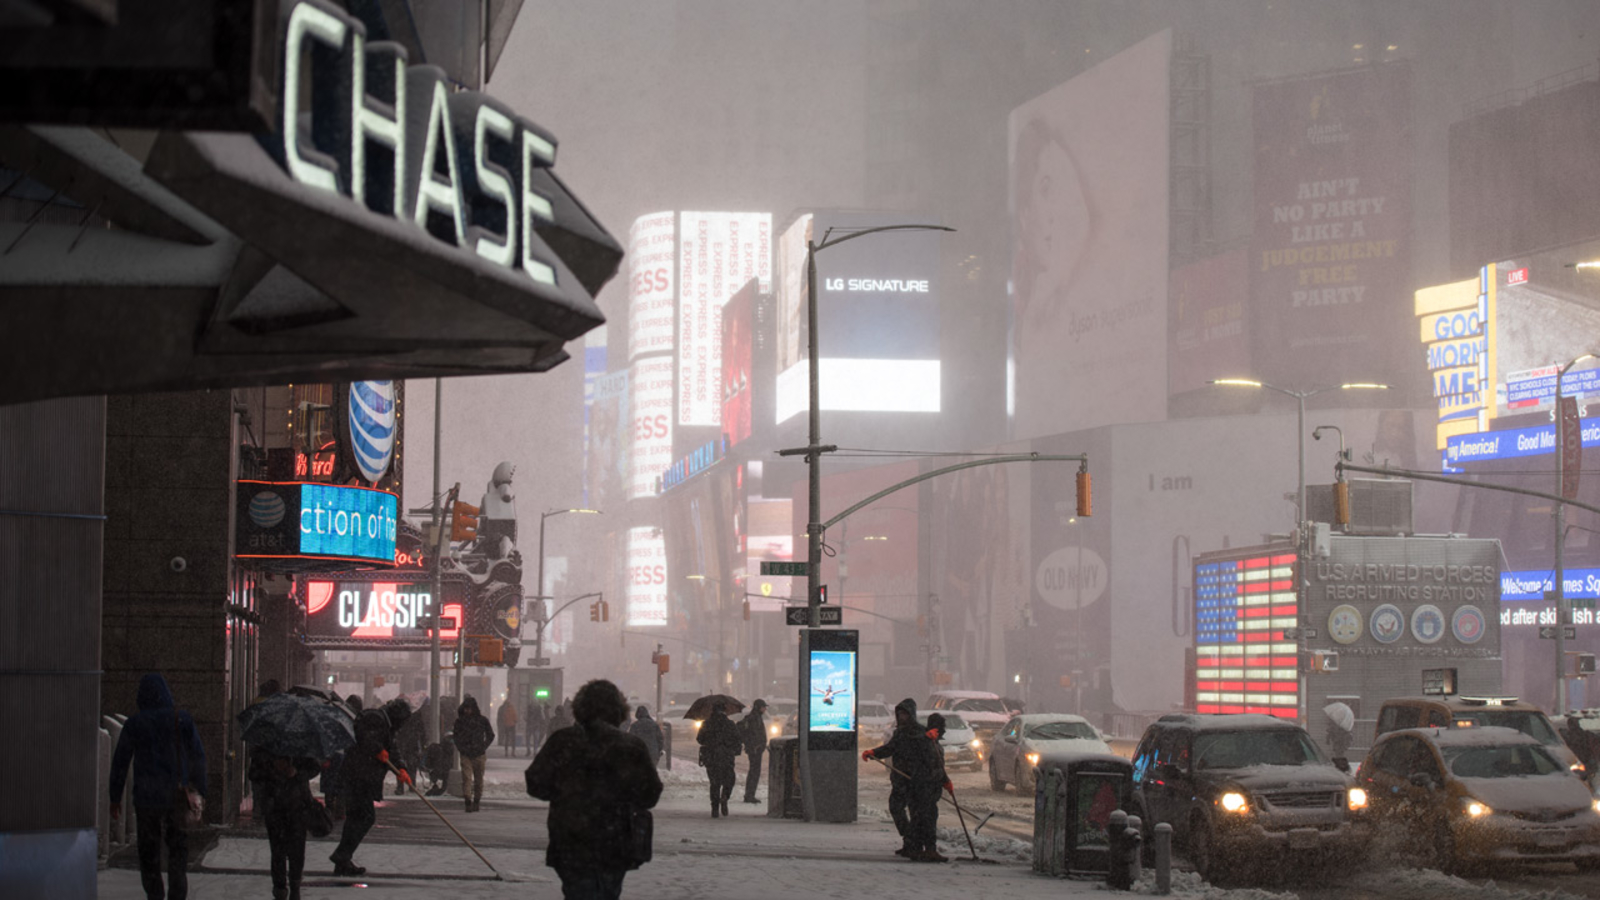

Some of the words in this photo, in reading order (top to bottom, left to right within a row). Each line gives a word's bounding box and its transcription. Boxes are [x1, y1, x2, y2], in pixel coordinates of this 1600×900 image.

[284, 2, 556, 286] CHASE
[1297, 177, 1359, 200] AIN'T
[1273, 205, 1305, 223] NO
[1311, 197, 1385, 220] PARTY
[1291, 222, 1344, 243] LIKE
[1350, 220, 1366, 239] A
[1261, 239, 1398, 272] JUDGEMENT
[826, 278, 844, 291] LG
[848, 279, 929, 293] SIGNATURE
[1299, 265, 1357, 286] FREE
[1508, 270, 1523, 283] LIVE
[1292, 285, 1366, 308] PARTY
[1459, 436, 1500, 457] America!
[1517, 433, 1539, 451] Good
[1149, 474, 1154, 492] I
[1162, 475, 1193, 491] am
[301, 501, 362, 537] ction
[368, 505, 384, 539] of
[250, 532, 285, 548] at&t
[1045, 567, 1066, 591] OLD
[1317, 563, 1348, 581] U.S.
[1349, 564, 1420, 581] ARMED
[1421, 565, 1495, 584] FORCES
[1325, 584, 1420, 600] RECRUITING
[1421, 585, 1486, 601] STATION
[1501, 577, 1541, 595] Welcome
[338, 590, 432, 629] CLASSIC
[1512, 608, 1538, 625] after
